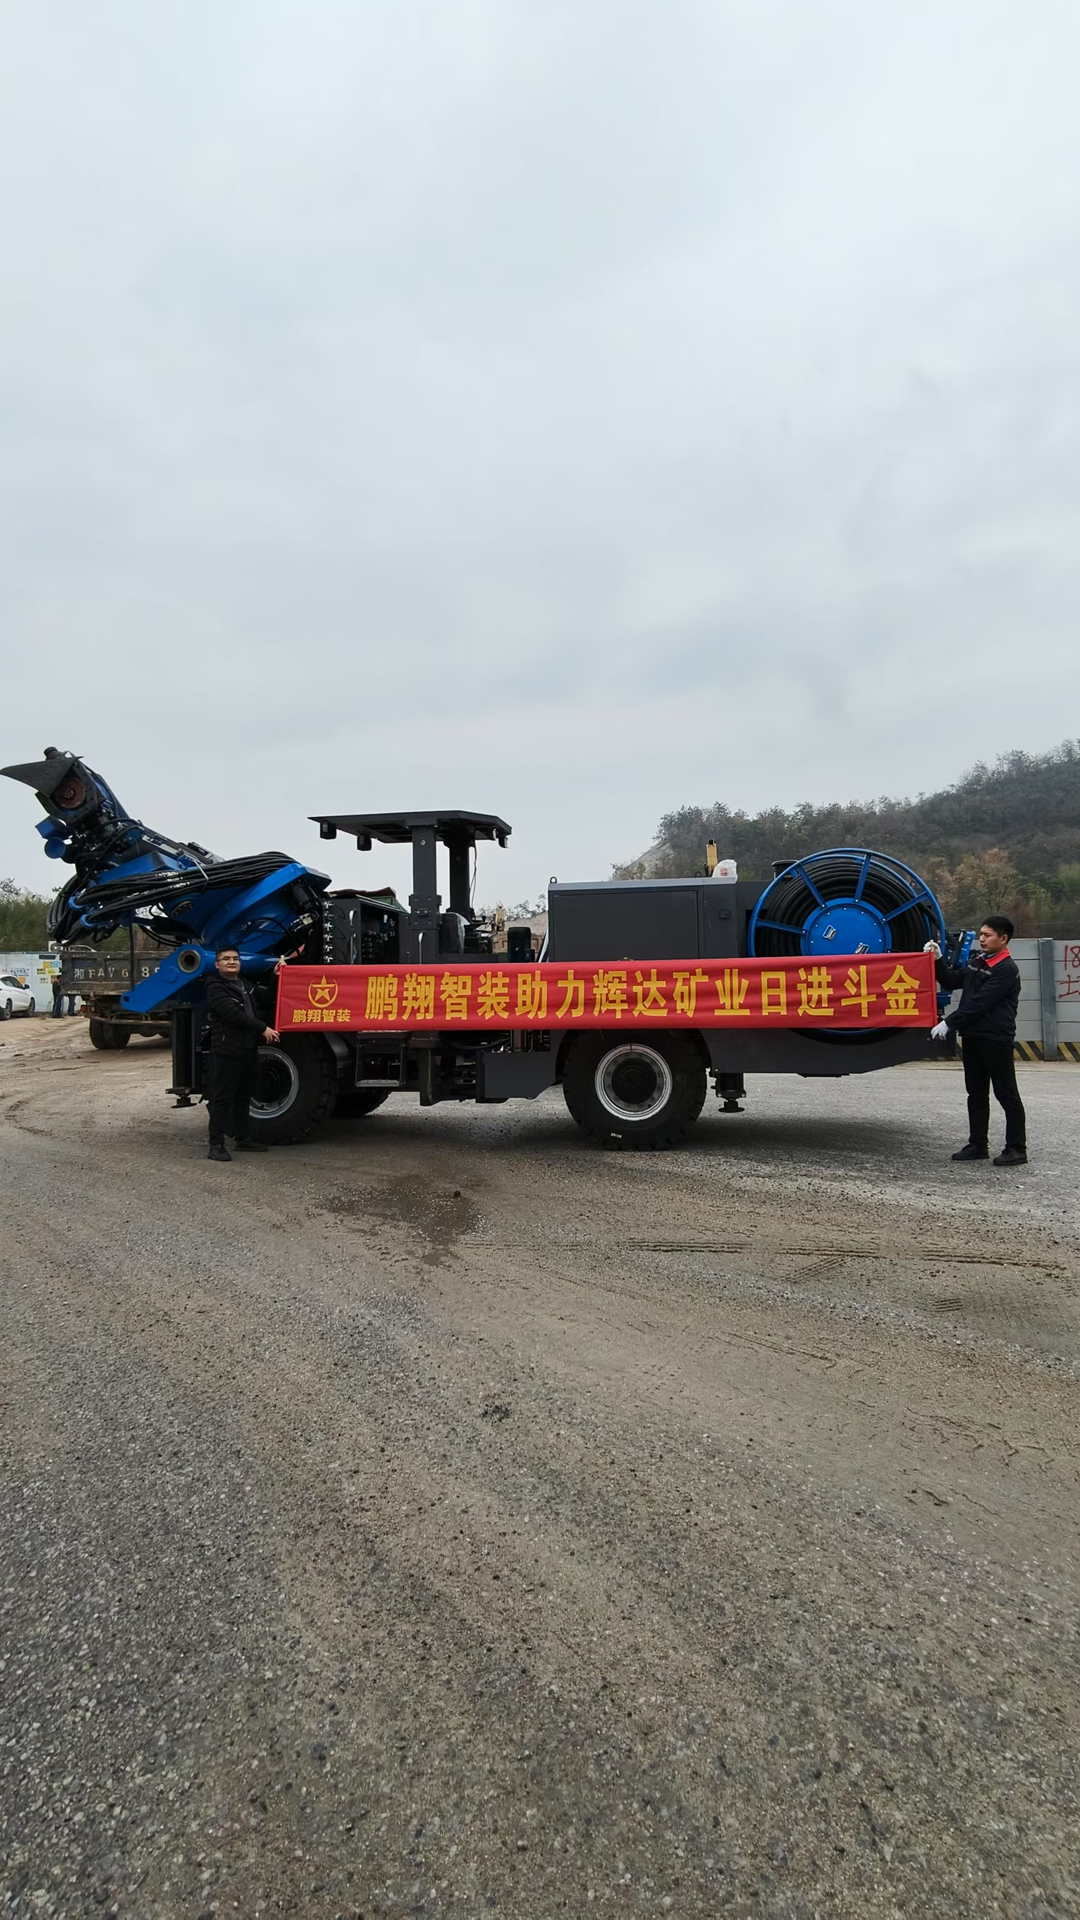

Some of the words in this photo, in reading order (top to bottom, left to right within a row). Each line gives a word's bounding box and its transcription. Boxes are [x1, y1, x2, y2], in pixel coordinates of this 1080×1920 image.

[365, 964, 920, 1020] 鹏翔智装助力辉达矿业日进斗金
[292, 1009, 352, 1023] 鹏翔智装
